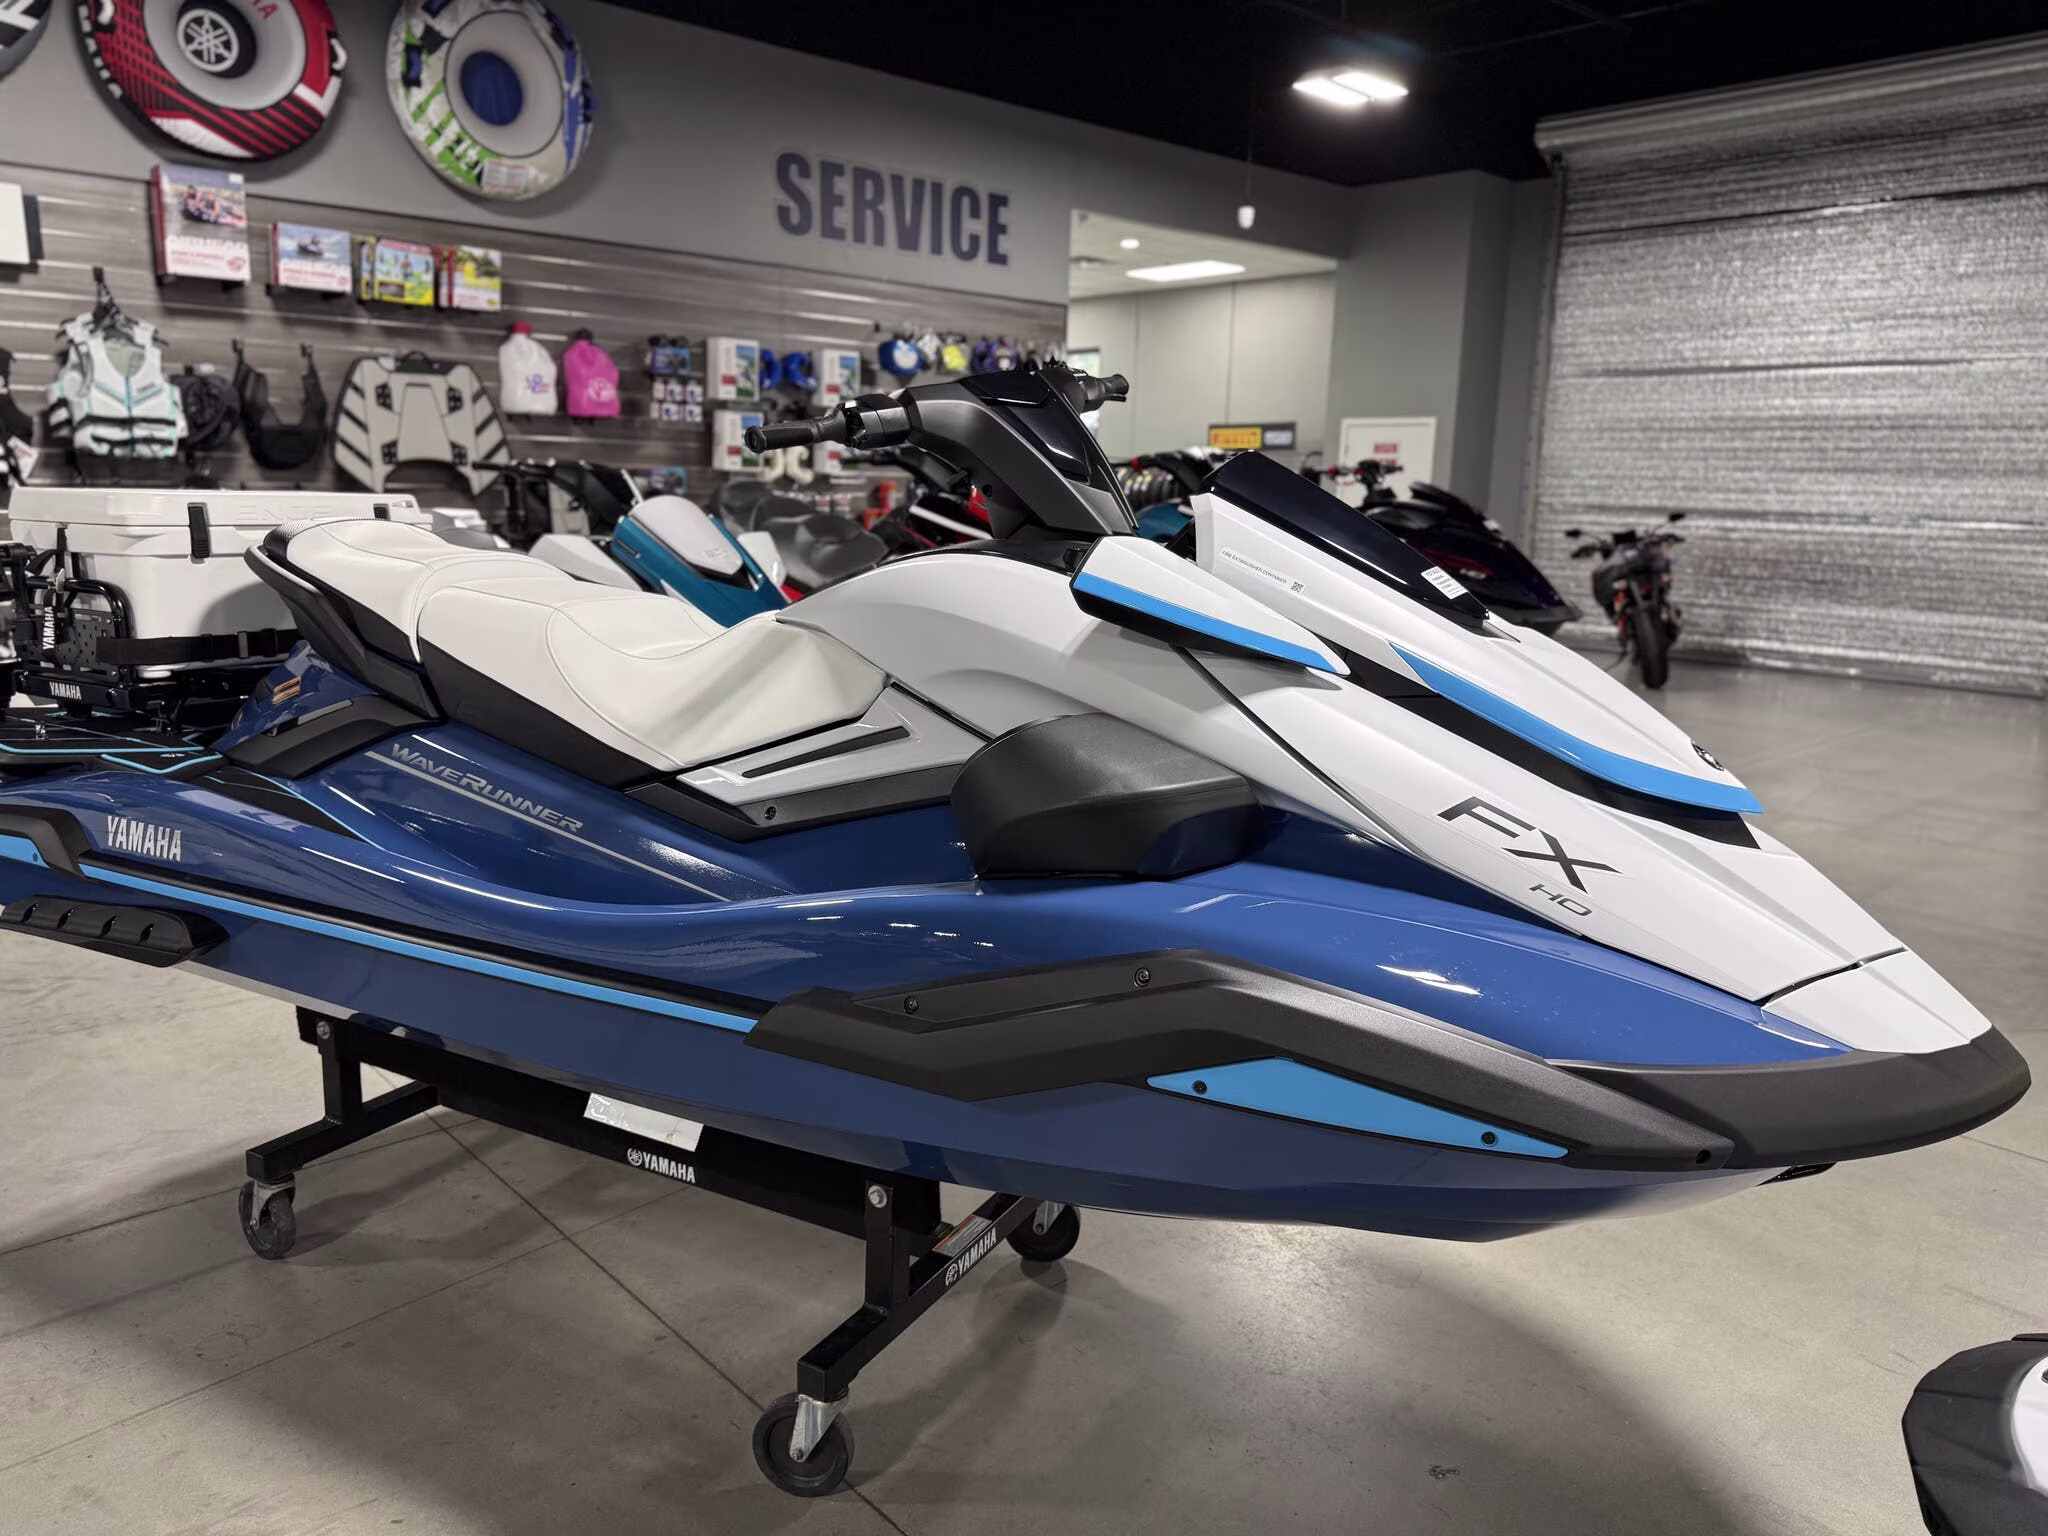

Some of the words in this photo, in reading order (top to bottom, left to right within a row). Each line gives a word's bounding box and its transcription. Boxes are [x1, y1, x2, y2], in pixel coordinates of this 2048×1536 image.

[776, 152, 1008, 266] SERVICE
[43, 606, 55, 650] YAMAHA
[49, 681, 82, 700] YAMAHA
[391, 743, 583, 832] WAVERUNNER
[107, 815, 182, 863] YAMAHA
[1437, 796, 1624, 894] FX
[1529, 883, 1593, 917] HO
[643, 1152, 696, 1183] YAMAHA
[957, 1227, 997, 1276] YAMAHA
